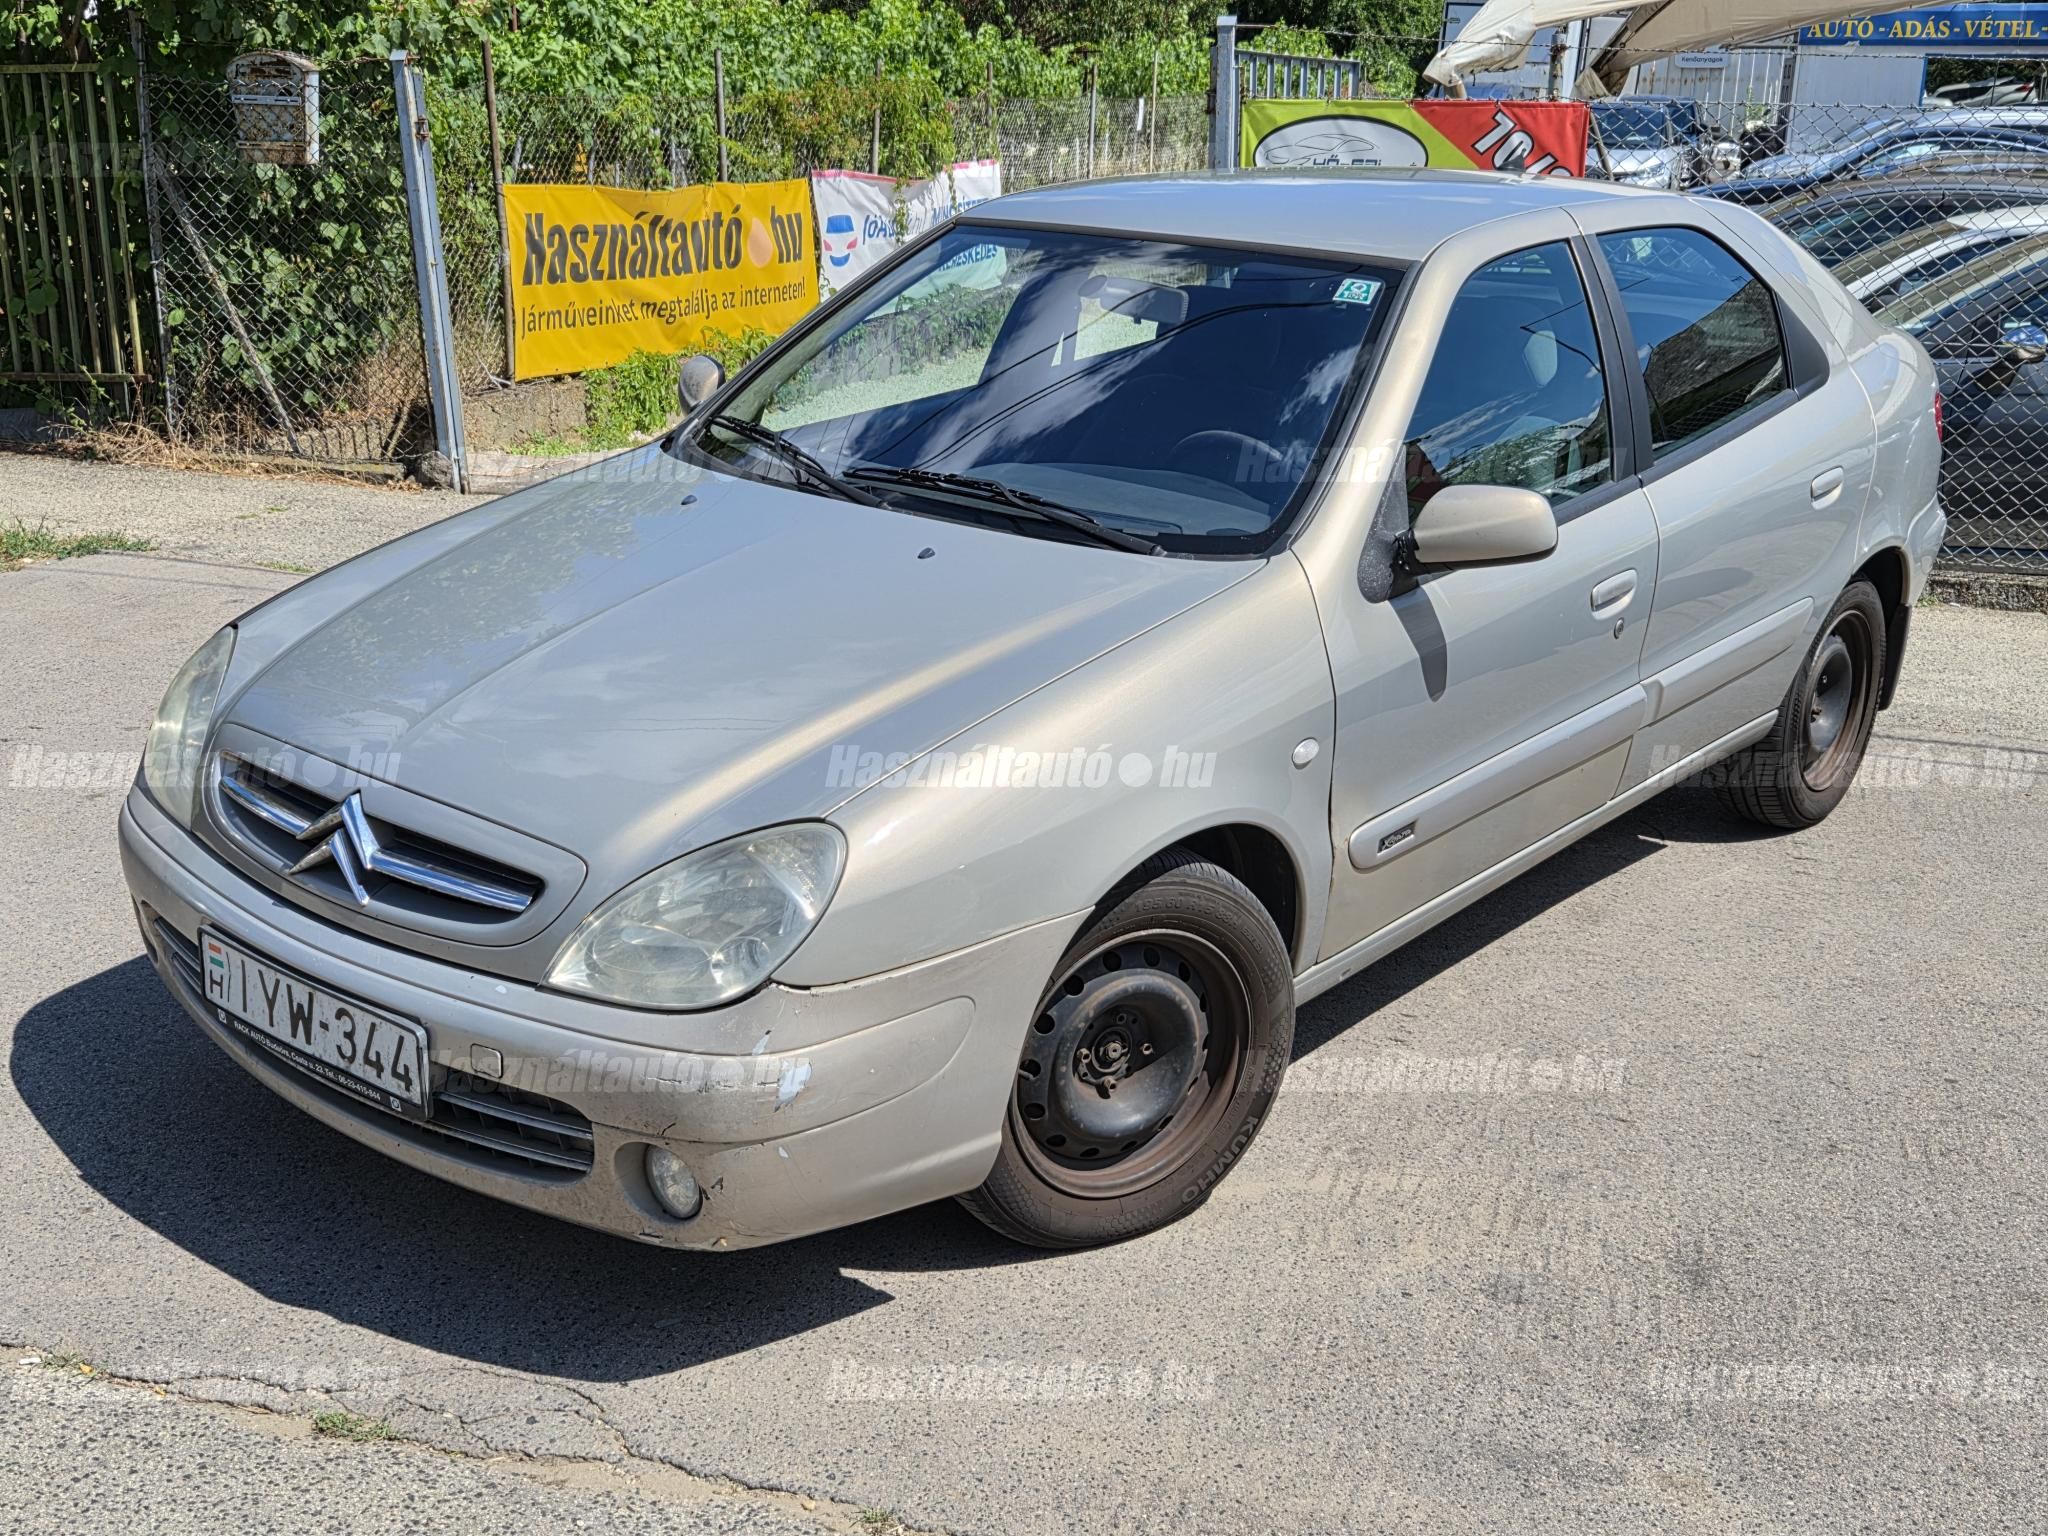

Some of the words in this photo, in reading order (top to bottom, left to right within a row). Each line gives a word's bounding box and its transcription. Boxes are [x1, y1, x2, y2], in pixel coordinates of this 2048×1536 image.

[1808, 16, 1873, 38] AUTÓ
[1888, 16, 1951, 38] ADÁS
[1964, 15, 2040, 38] VÉTEL
[521, 299, 639, 340] Járműveinket
[640, 288, 718, 326] megtalálja
[721, 291, 736, 309] az
[740, 276, 806, 306] interneten!
[240, 958, 413, 1092] IYW-344
[1181, 1115, 1259, 1204] KUMHO
